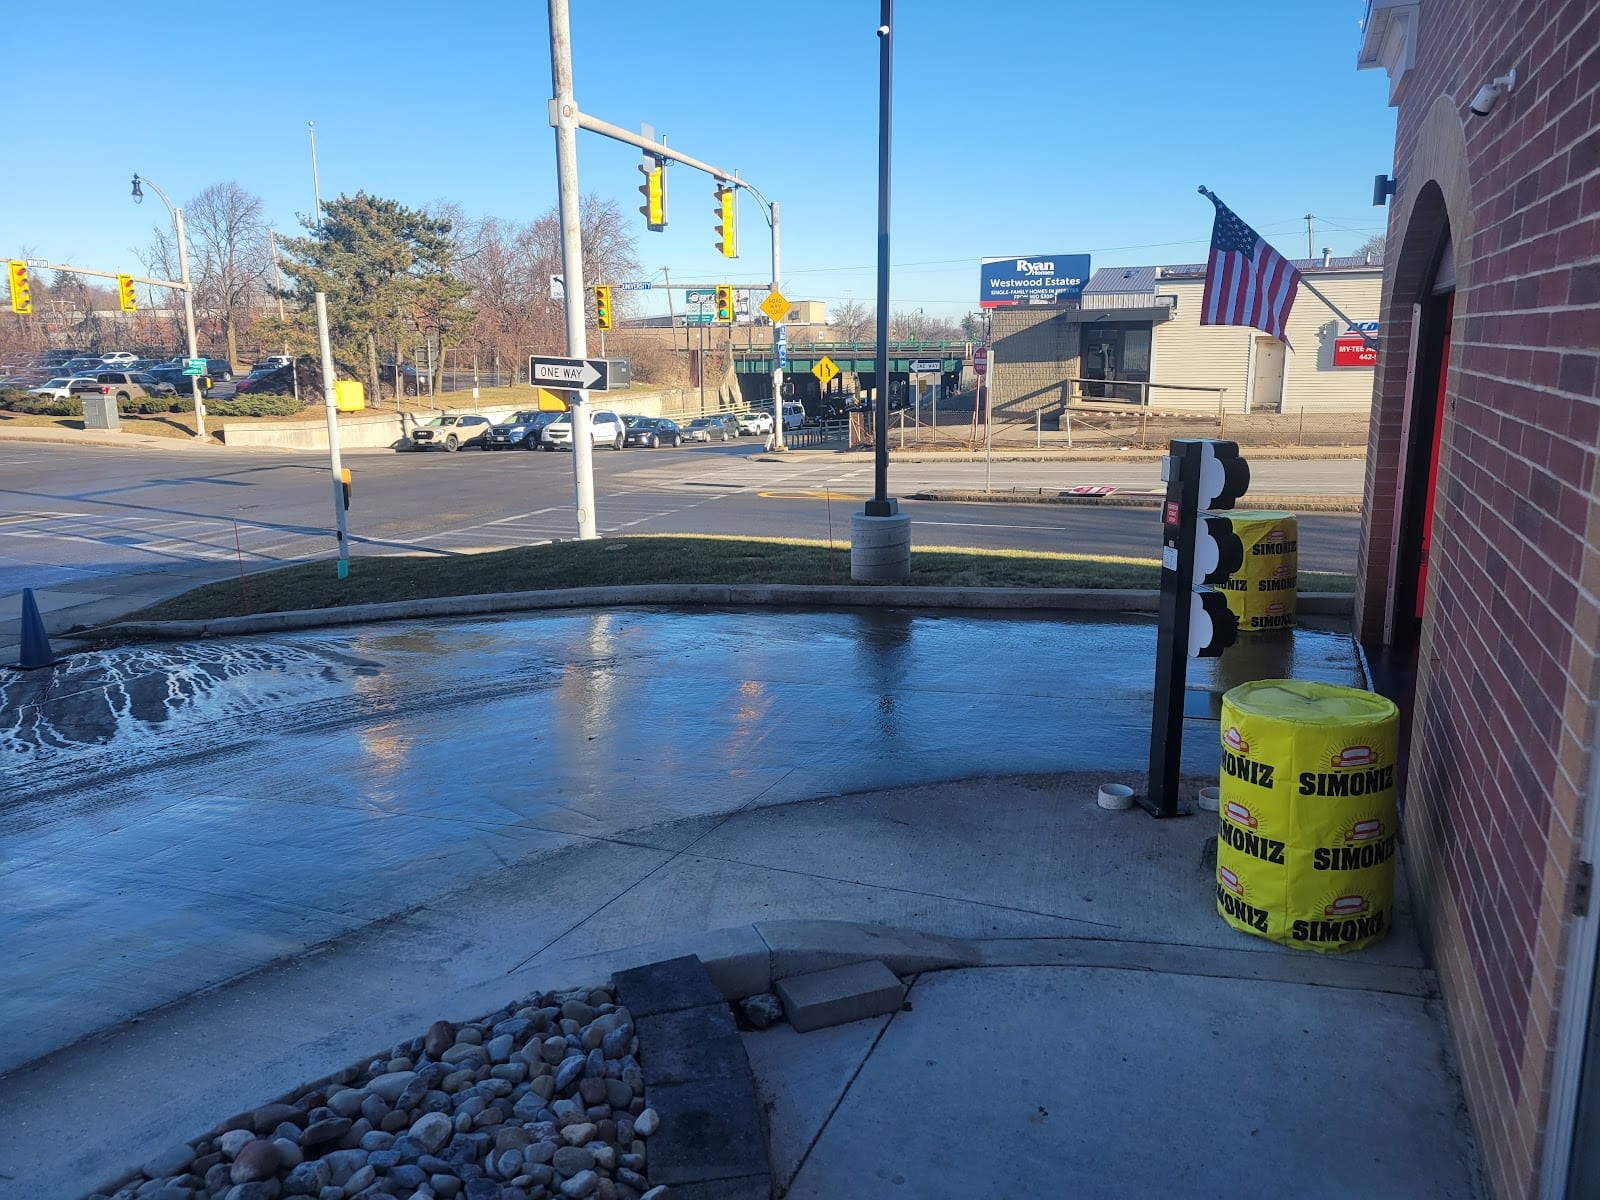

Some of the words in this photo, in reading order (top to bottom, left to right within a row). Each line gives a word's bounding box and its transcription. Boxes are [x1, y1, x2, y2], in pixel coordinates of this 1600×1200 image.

[1017, 260, 1055, 276] Ryan
[990, 279, 1042, 288] Westwood
[1045, 277, 1081, 286] Estates
[540, 366, 560, 378] ONE
[563, 368, 583, 379] WAY
[1252, 540, 1297, 556] SIMONIZ
[1298, 763, 1394, 797] SIMONIZ
